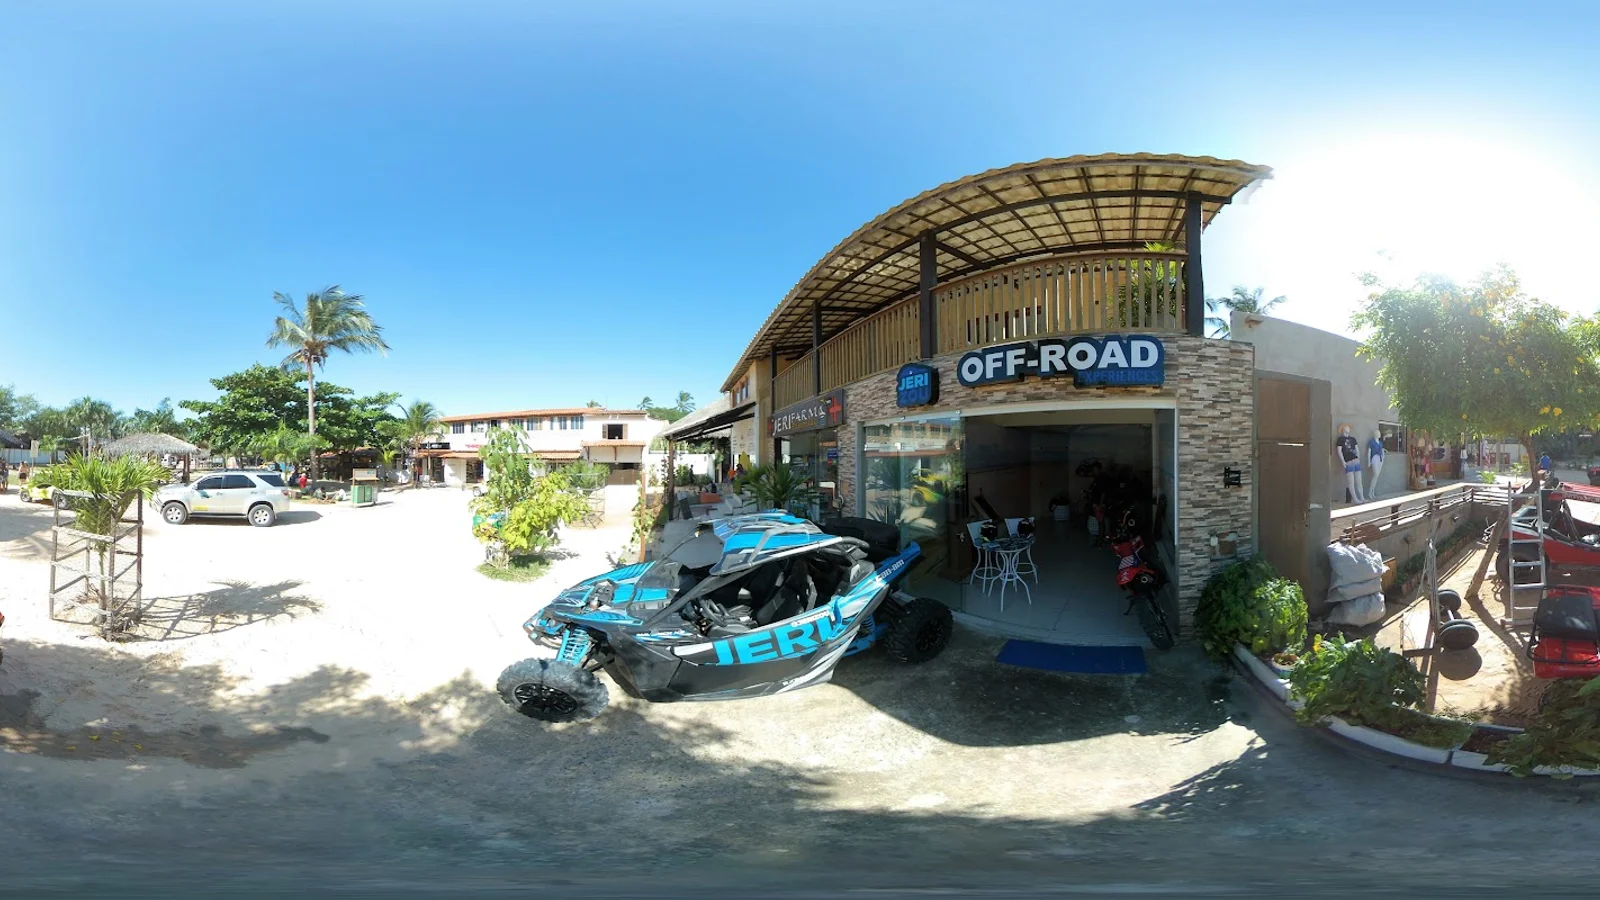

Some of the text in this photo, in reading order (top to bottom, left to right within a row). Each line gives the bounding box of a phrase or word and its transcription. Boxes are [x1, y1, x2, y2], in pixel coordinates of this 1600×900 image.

[961, 339, 1159, 383] OFF-ROAD
[898, 372, 929, 391] JERI
[1078, 370, 1158, 383] EXPERIENCES
